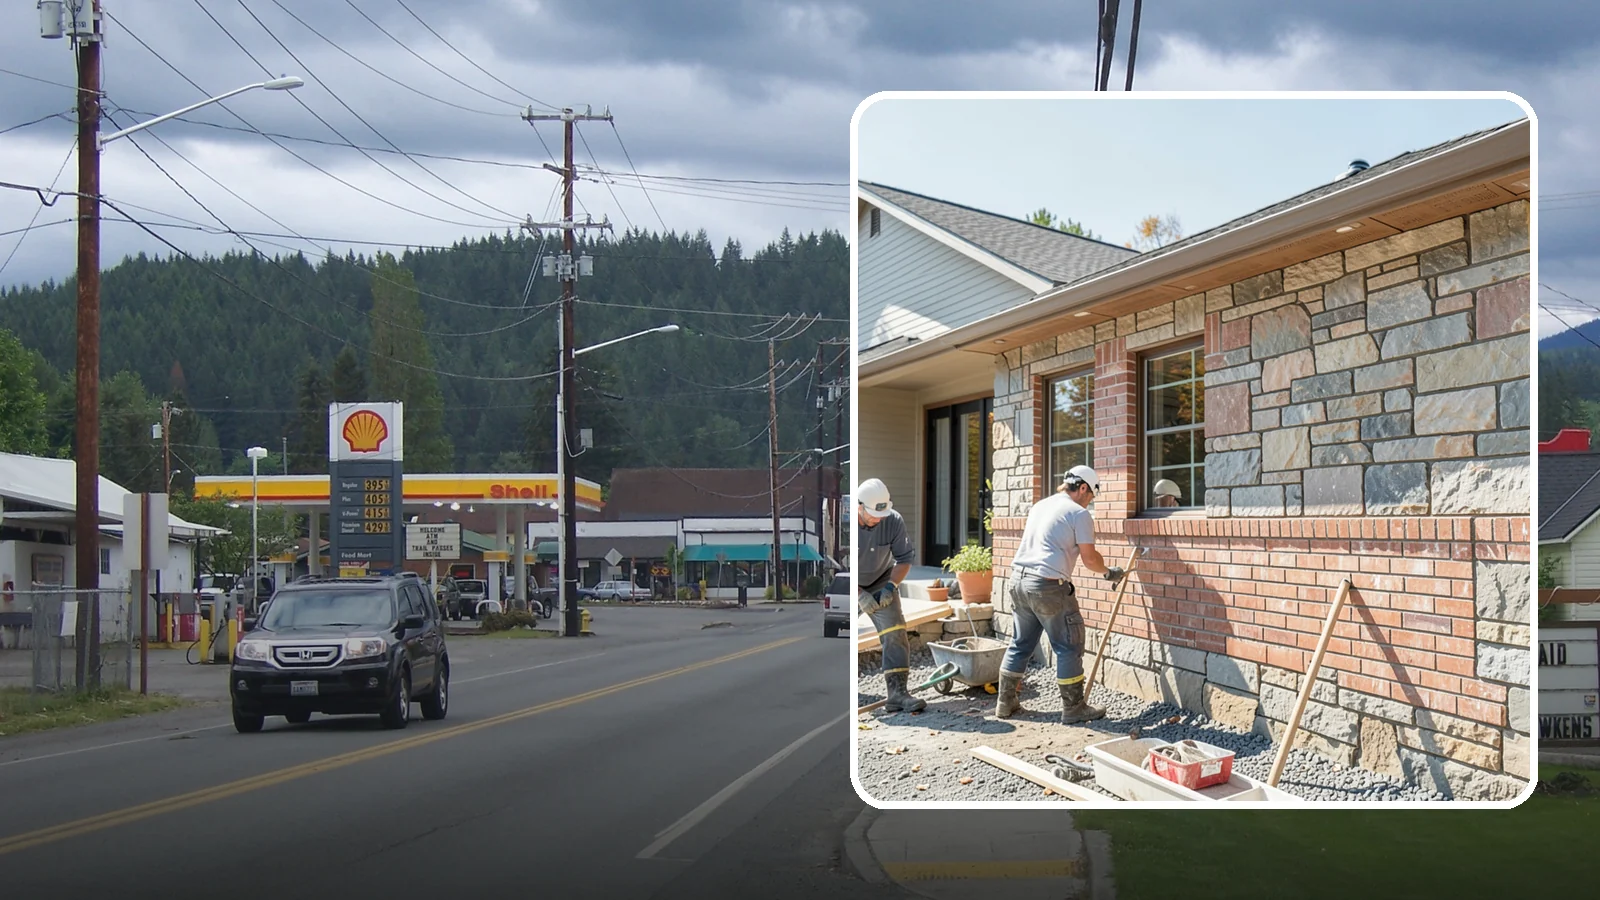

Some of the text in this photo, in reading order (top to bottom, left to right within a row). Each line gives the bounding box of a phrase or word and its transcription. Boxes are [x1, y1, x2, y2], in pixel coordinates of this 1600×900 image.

[366, 480, 383, 490] 395
[490, 484, 547, 499] Shell
[366, 494, 383, 504] 405
[366, 508, 383, 518] 415
[366, 522, 383, 532] 429
